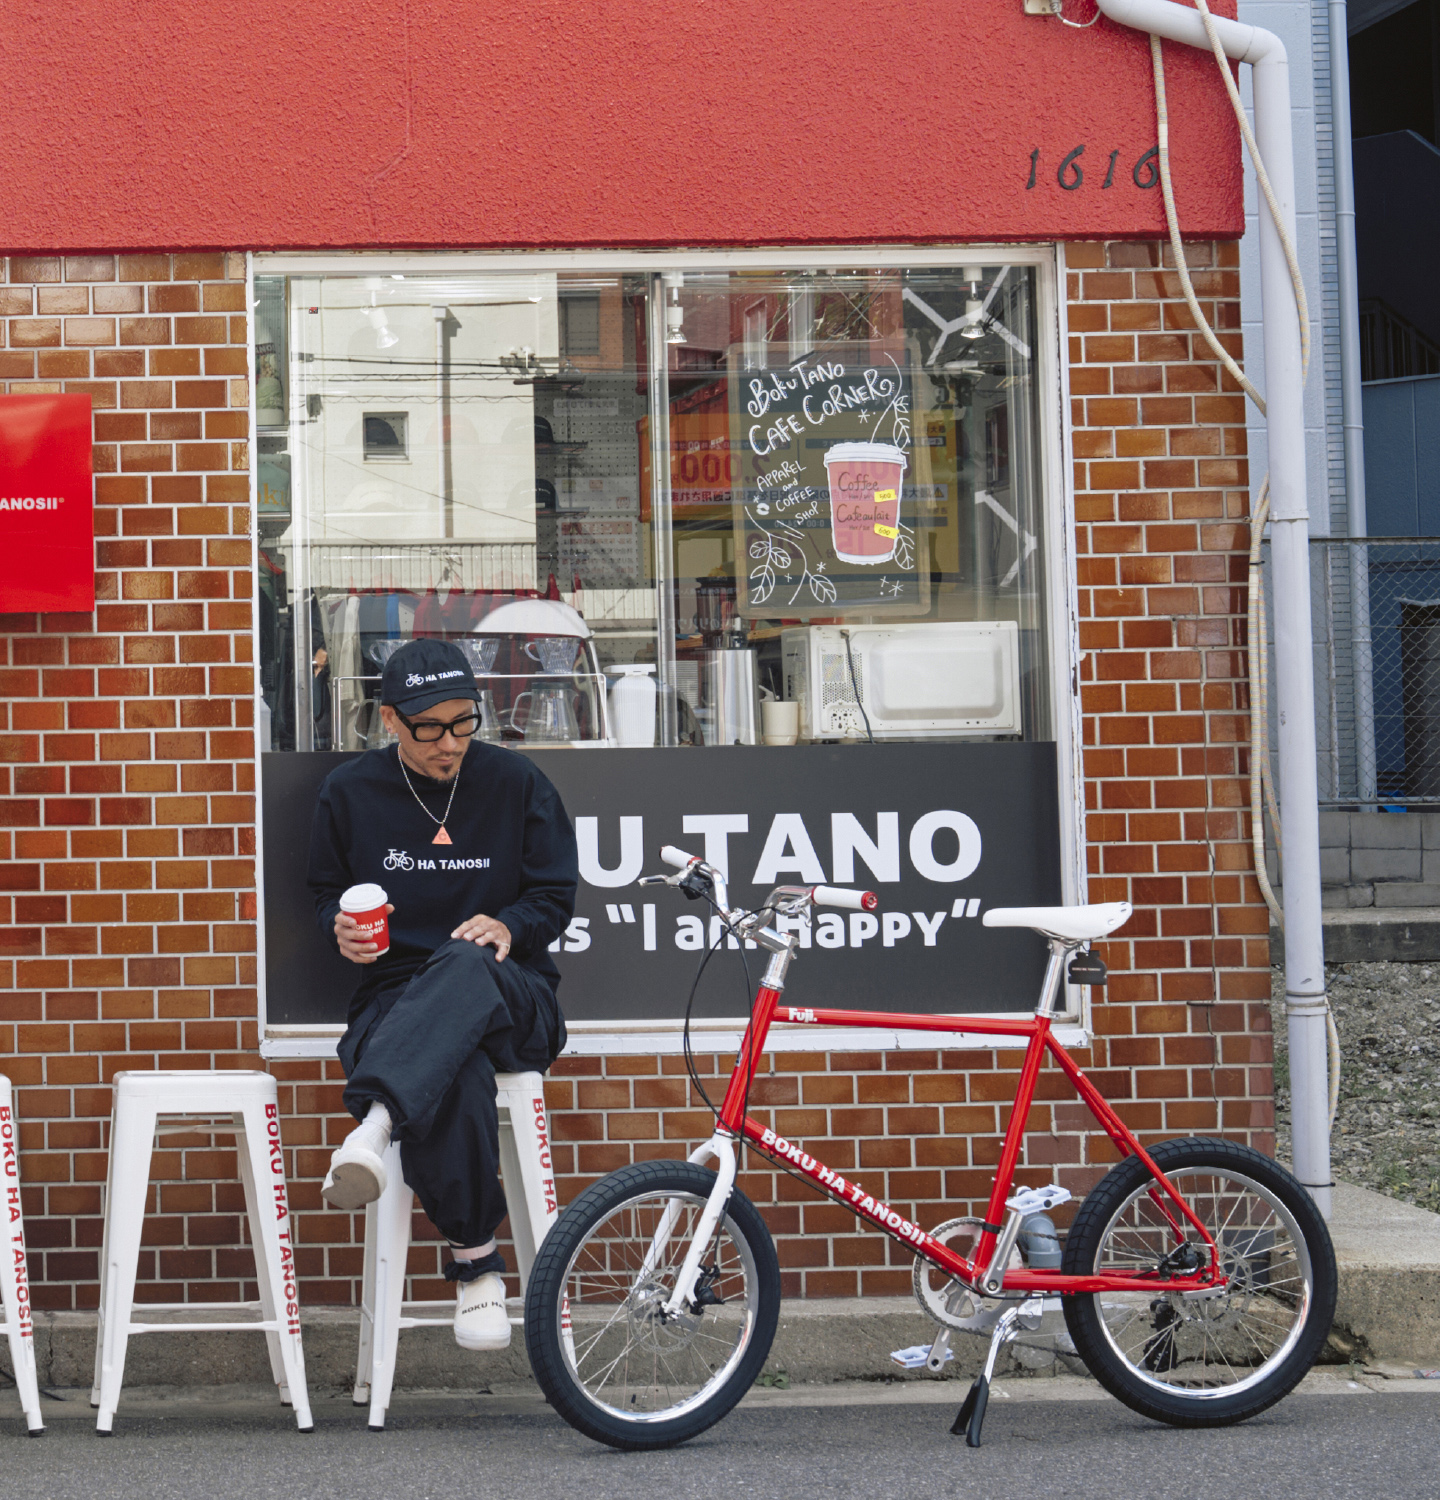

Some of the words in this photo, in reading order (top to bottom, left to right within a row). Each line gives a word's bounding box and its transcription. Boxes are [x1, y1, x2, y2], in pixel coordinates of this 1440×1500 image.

[1026, 144, 1160, 191] 1616
[425, 674, 438, 683] HA
[417, 859, 437, 870] HA
[439, 858, 491, 870] TANOSII
[682, 809, 983, 886] TANO
[0, 1105, 17, 1177] BOKU
[264, 1103, 283, 1175] BOKU
[532, 1098, 551, 1169] BOKU
[542, 1178, 558, 1215] HA
[761, 1128, 815, 1172] BOKU
[817, 1168, 845, 1194] HA
[6, 1187, 21, 1223] HA
[273, 1184, 288, 1221] HA
